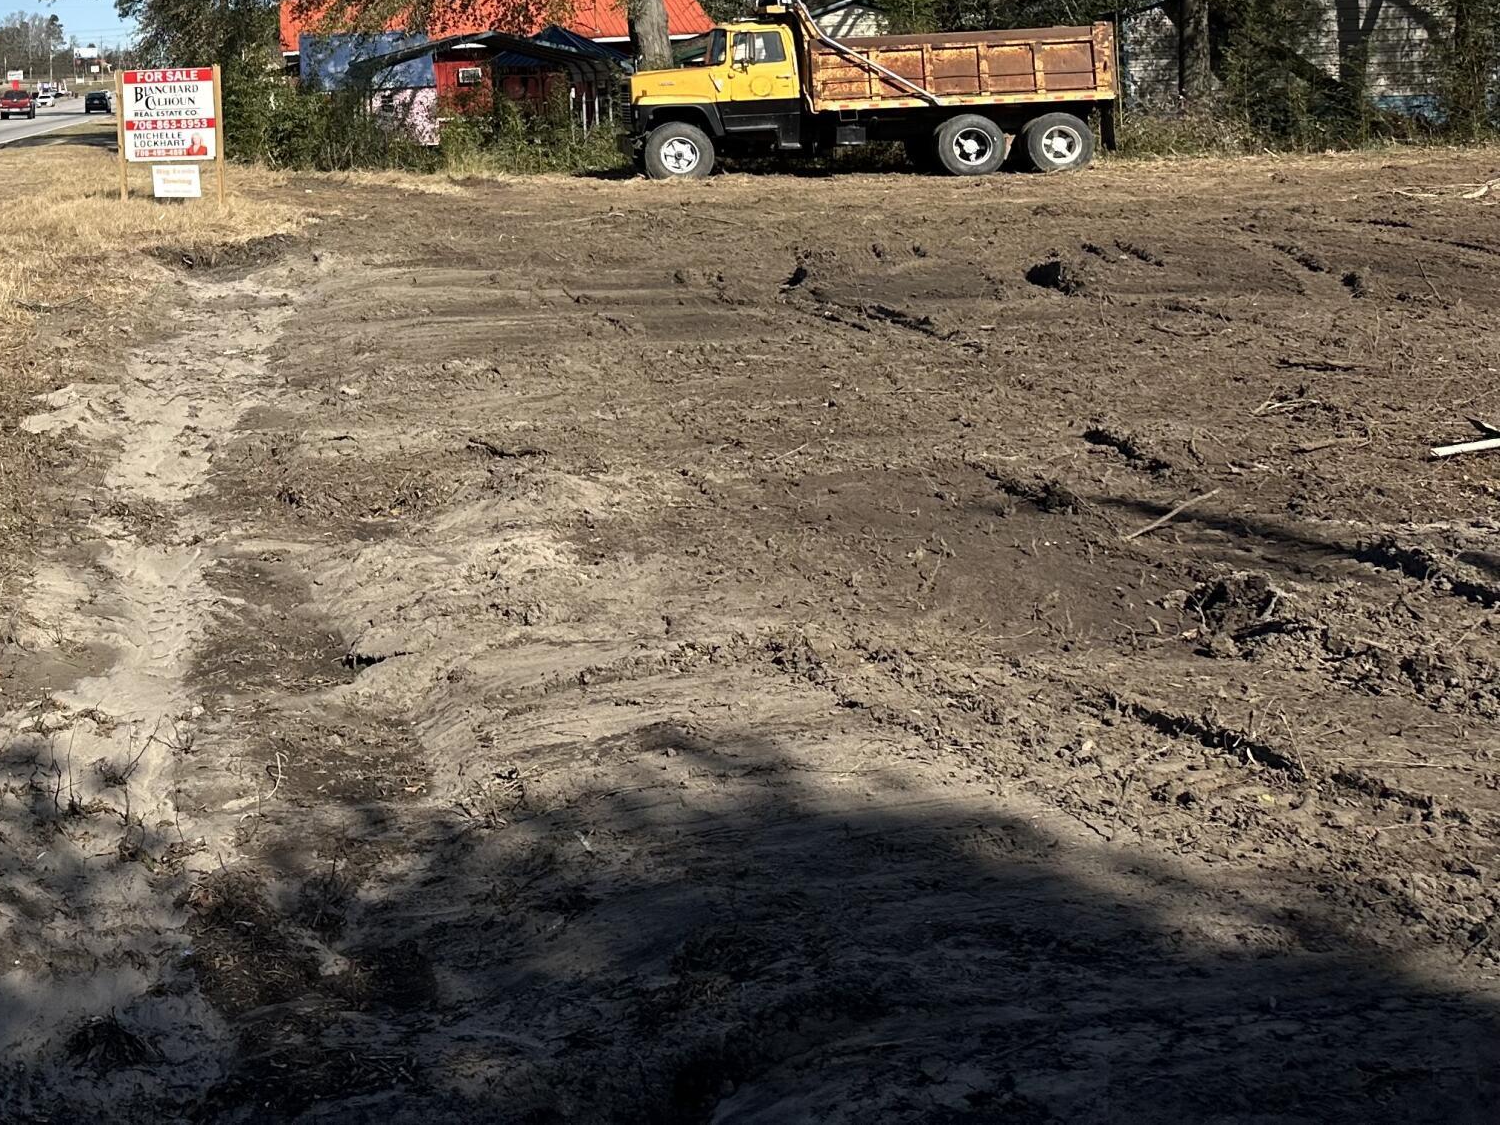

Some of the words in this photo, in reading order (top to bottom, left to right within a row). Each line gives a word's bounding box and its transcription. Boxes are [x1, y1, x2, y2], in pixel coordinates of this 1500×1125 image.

[136, 72, 163, 82] FOR
[165, 70, 198, 81] SALE
[134, 84, 199, 103] BLANCHARD
[145, 96, 196, 110] CALHOUN
[132, 119, 208, 130] 706-863-8953
[133, 132, 183, 140] MICHELLE
[134, 139, 186, 148] LOCKHART
